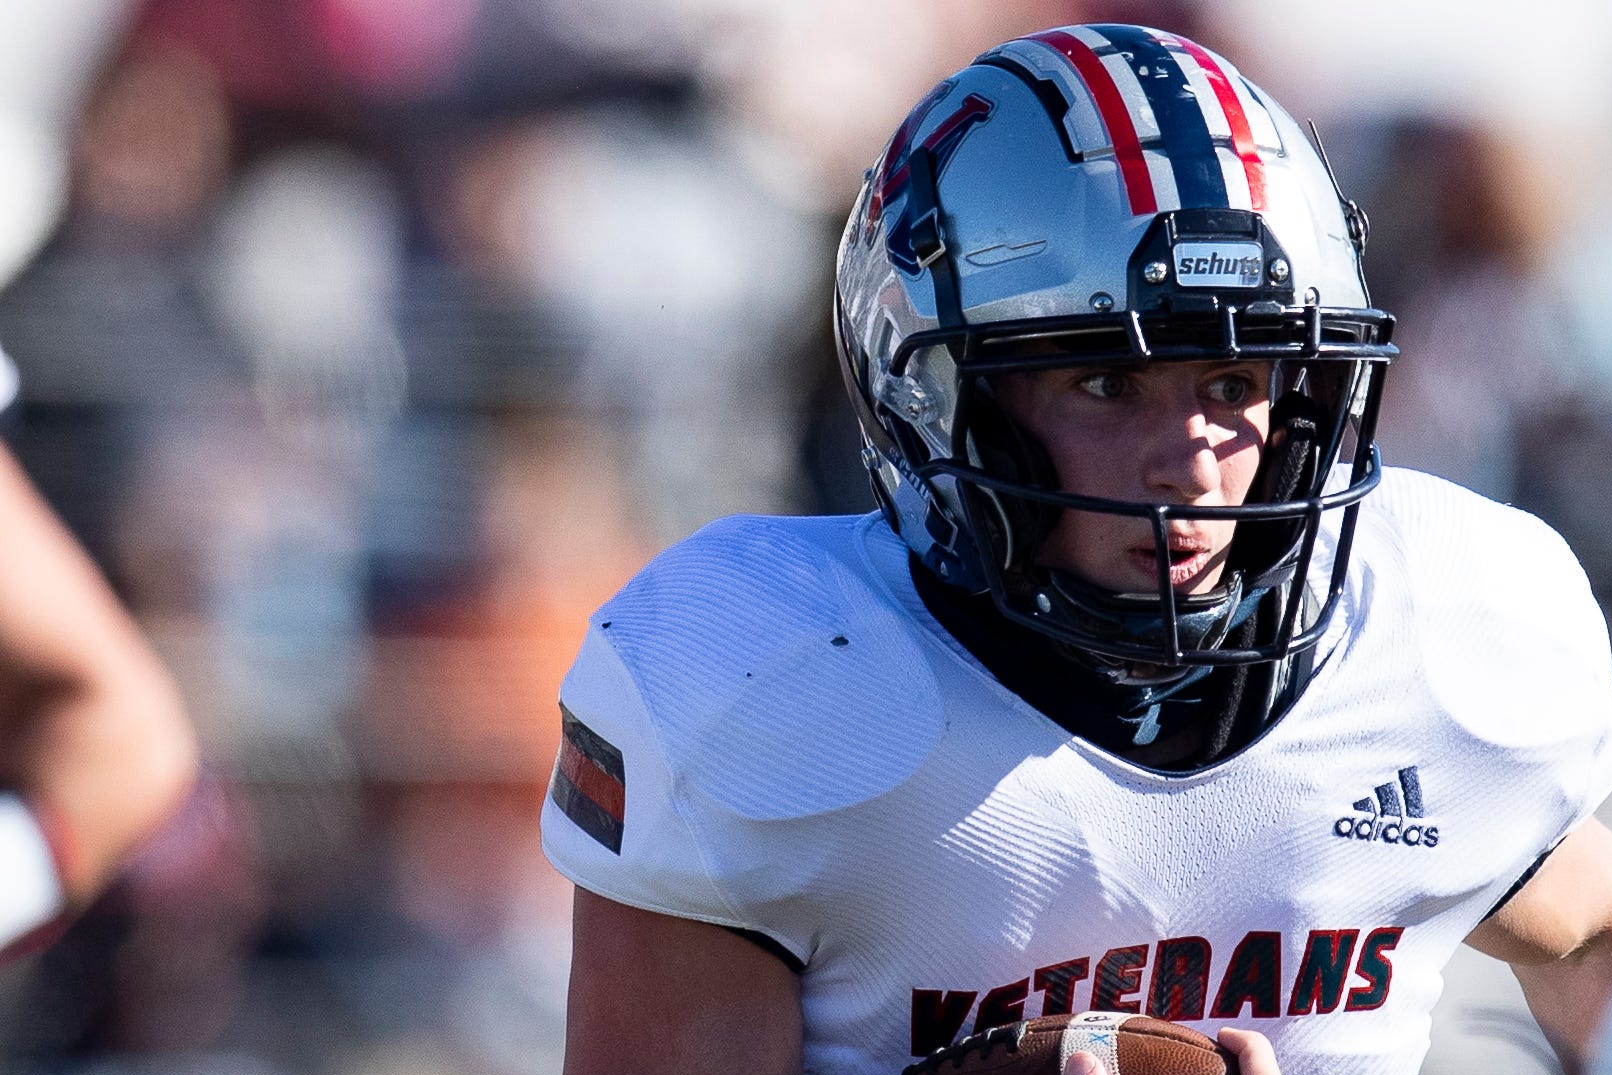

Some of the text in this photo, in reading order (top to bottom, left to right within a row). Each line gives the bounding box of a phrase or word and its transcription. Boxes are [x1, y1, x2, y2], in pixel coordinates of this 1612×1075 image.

[1179, 252, 1260, 275] schutt
[1334, 812, 1440, 848] adidas
[911, 926, 1406, 1058] VETERANS
